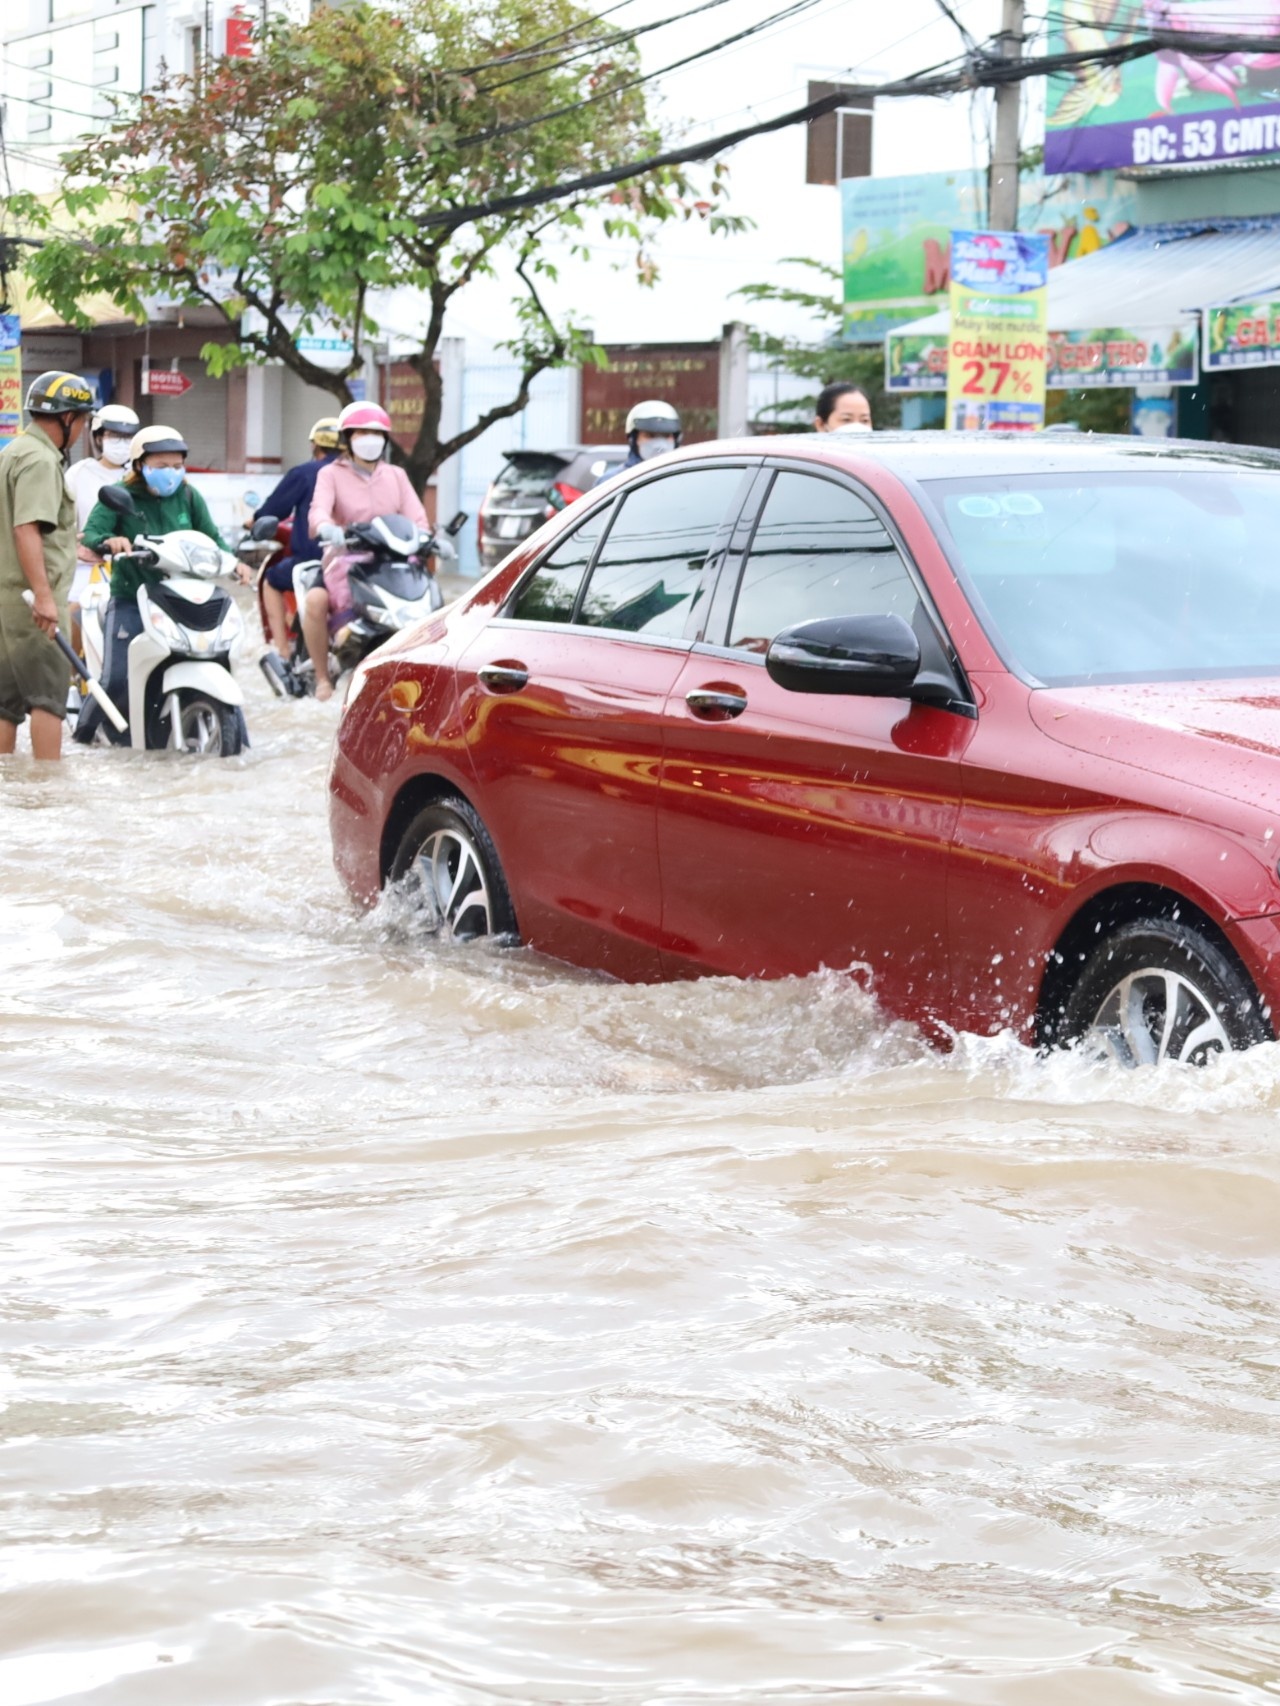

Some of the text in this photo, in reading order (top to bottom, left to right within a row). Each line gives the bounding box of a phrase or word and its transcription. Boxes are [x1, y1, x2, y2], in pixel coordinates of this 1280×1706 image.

[1132, 125, 1177, 164] ĐC:
[1182, 119, 1217, 160] 53
[952, 336, 1001, 359] GIẢM
[1006, 339, 1044, 360] LỚN
[151, 372, 183, 385] HOTEL
[962, 361, 1033, 395] 27%
[62, 386, 91, 401] BVDP
